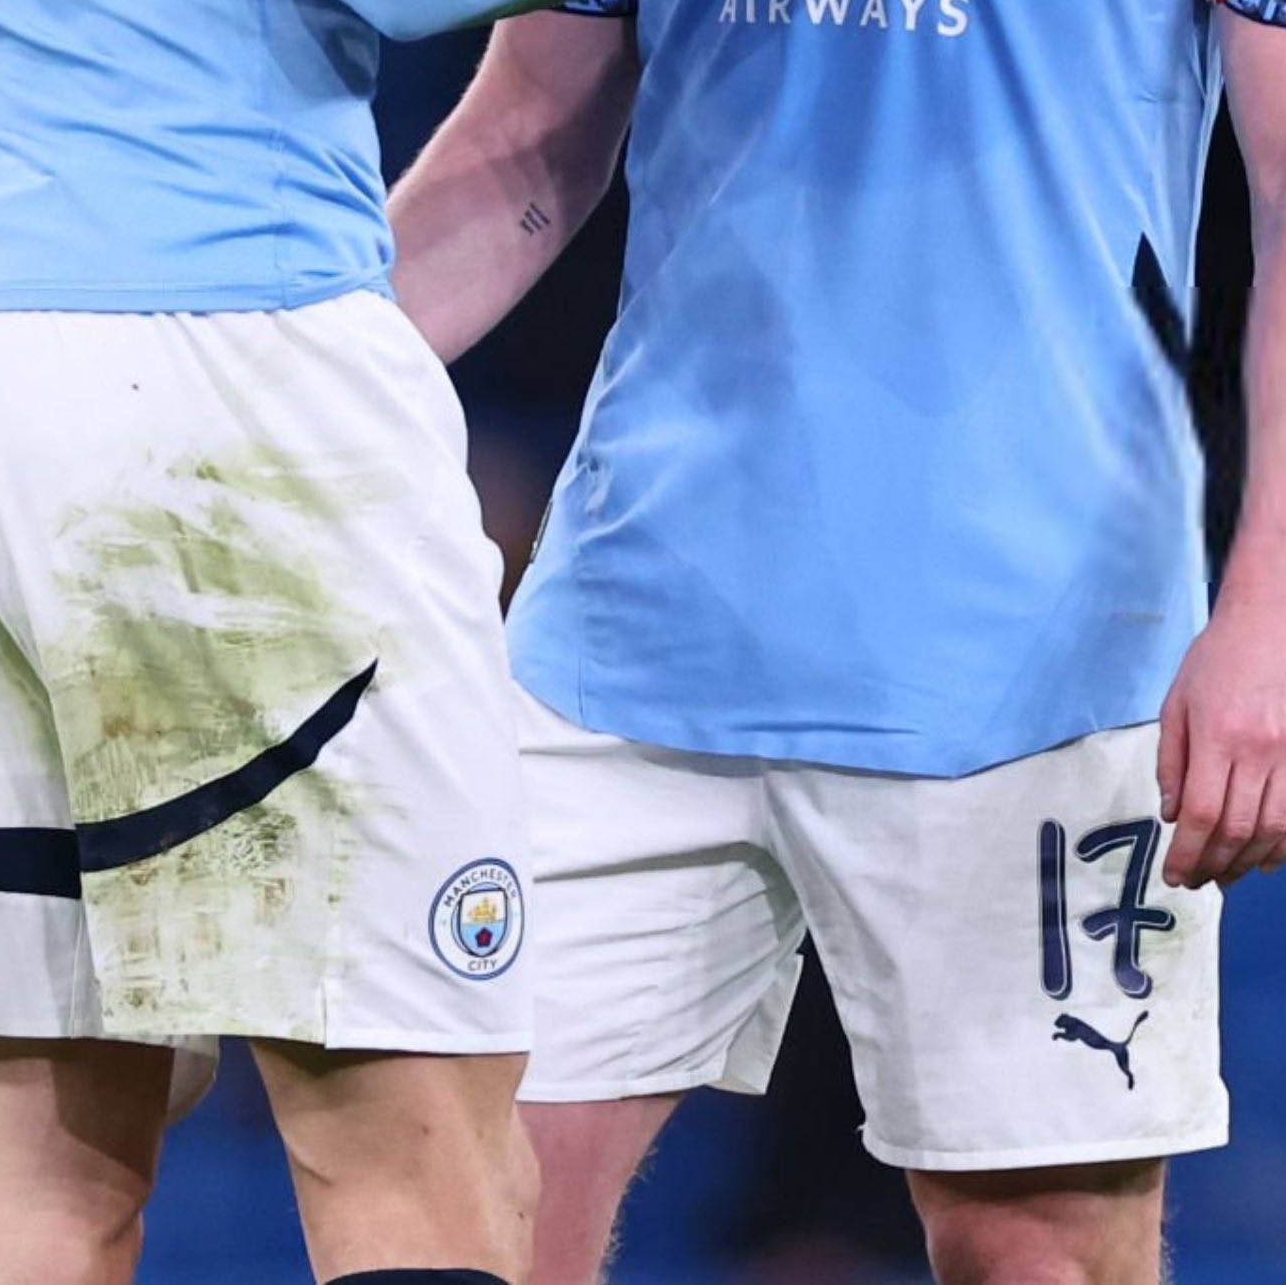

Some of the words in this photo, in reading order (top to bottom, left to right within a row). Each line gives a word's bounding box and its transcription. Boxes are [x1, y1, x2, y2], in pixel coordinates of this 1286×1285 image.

[443, 868, 517, 907] MANCHESTER
[1037, 816, 1176, 1001] 17
[467, 958, 498, 972] CITY
